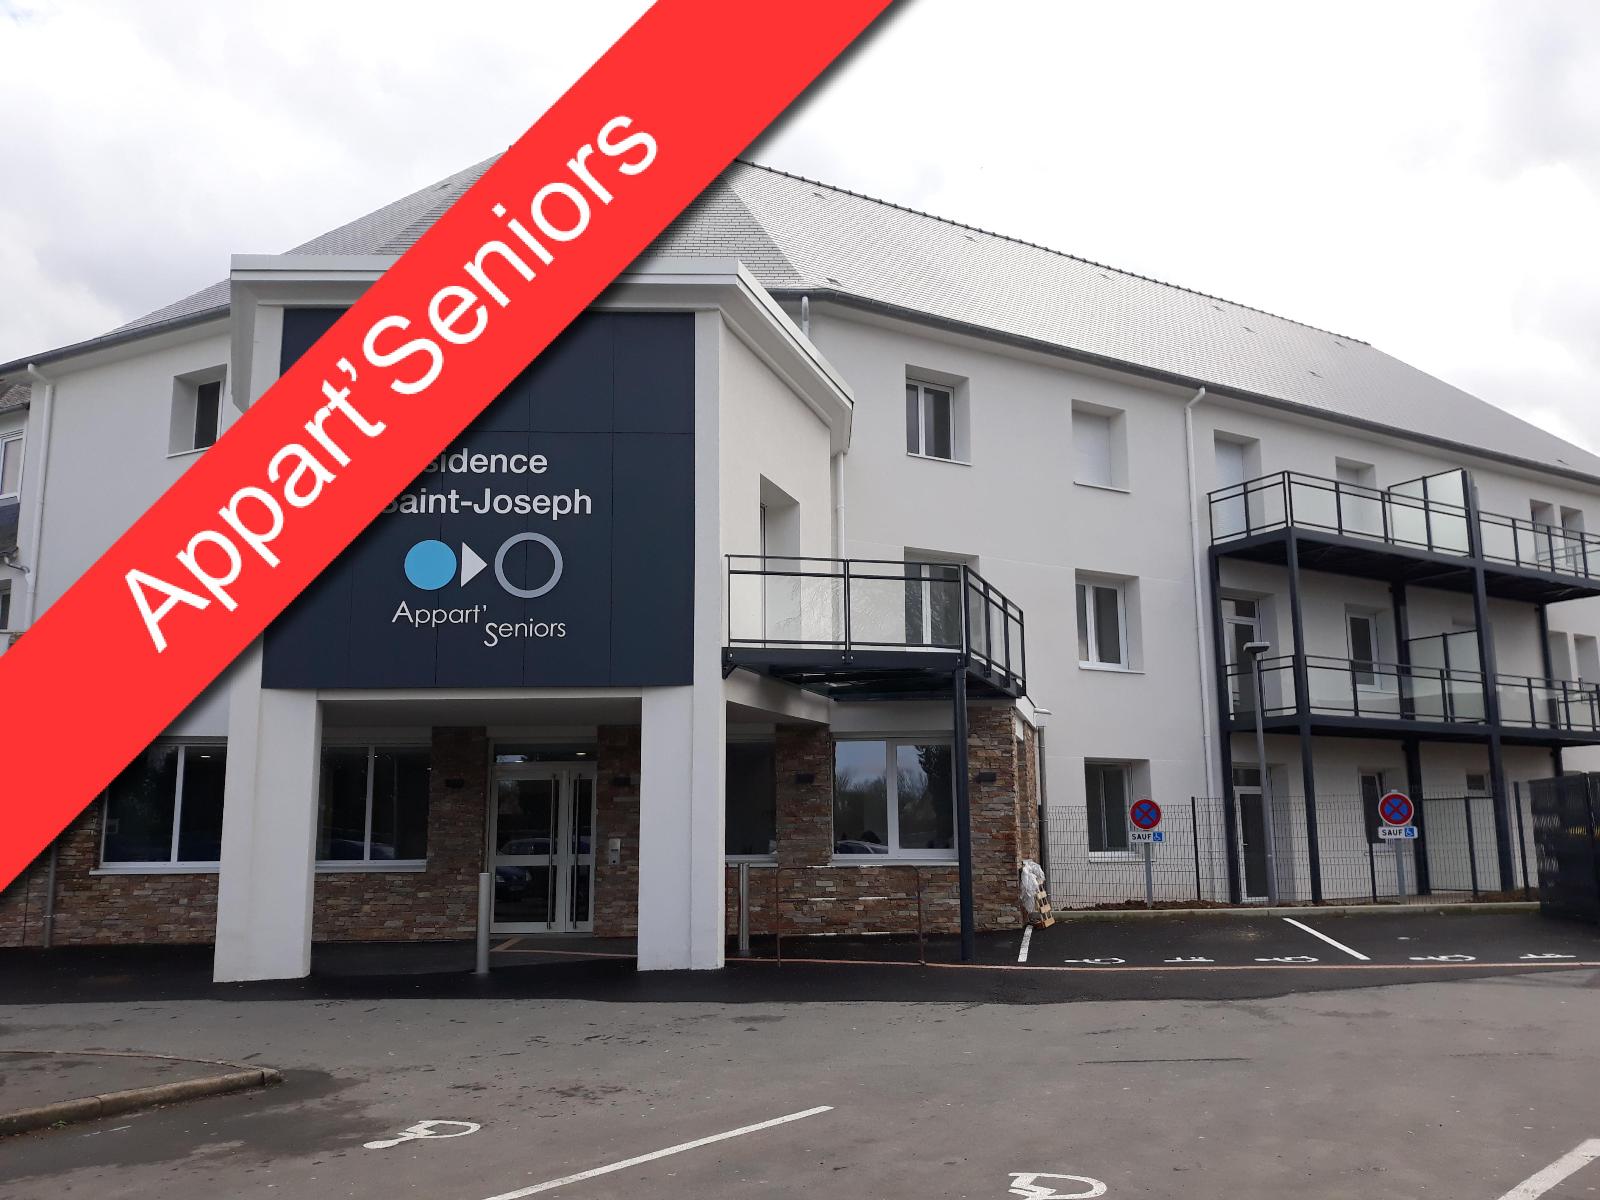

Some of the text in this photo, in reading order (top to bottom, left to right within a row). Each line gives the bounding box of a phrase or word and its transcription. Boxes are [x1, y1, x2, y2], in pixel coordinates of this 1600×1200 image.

[391, 600, 566, 647] Appart' Seniors
[1131, 833, 1152, 841] SAUF
[1382, 829, 1403, 837] SAUF
